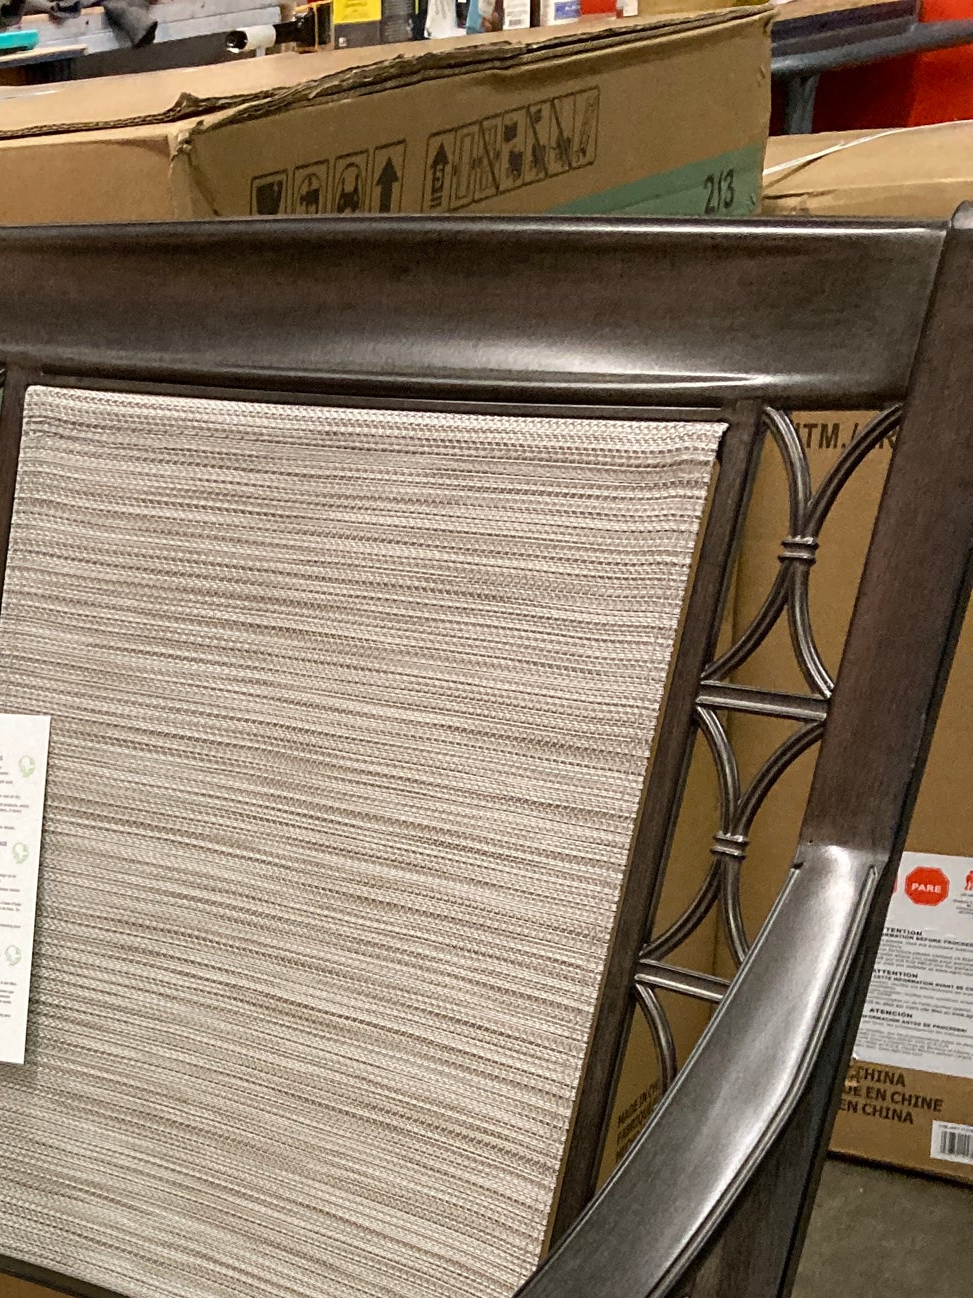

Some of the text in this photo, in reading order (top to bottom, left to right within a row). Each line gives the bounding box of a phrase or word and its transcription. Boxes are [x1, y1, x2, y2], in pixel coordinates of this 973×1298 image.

[911, 882, 942, 894] PARE
[867, 1085, 887, 1102] EN
[890, 1091, 944, 1114] CHINE
[862, 1103, 915, 1125] CHINA
